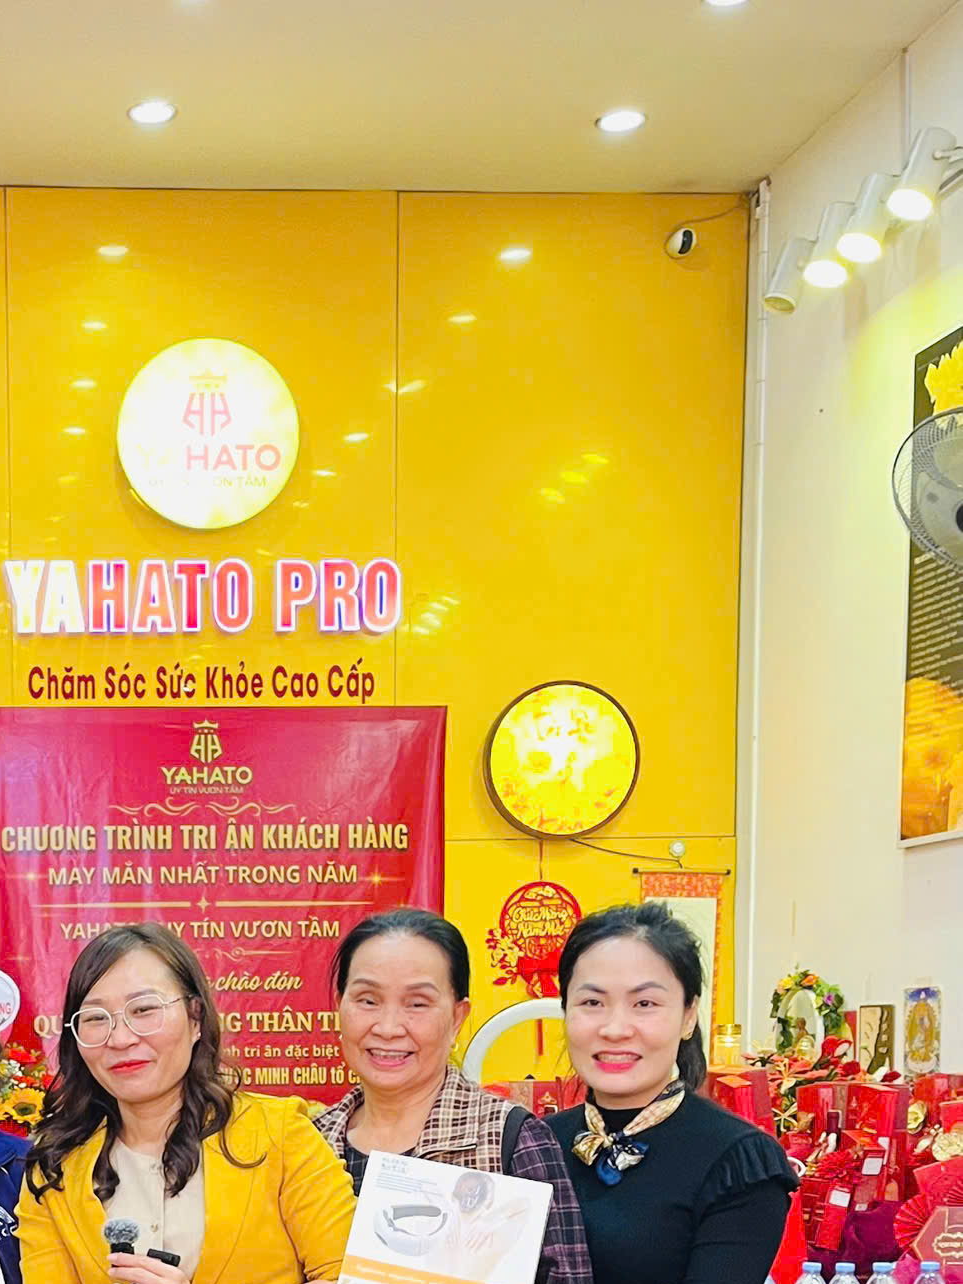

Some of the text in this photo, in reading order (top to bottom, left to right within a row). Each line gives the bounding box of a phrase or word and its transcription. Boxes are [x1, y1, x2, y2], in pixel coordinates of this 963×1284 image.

[4, 558, 402, 634] YAHATO PRO
[28, 657, 375, 704] Chăm Sóc Sức Khỏe Cao Cấp
[161, 766, 253, 785] YAHATO
[1, 816, 408, 852] CHƯƠNG TRÌNH TRI ÂN KHÁCH HÀNG
[48, 867, 95, 885] MAY
[160, 860, 219, 884] NHẤT
[225, 865, 300, 884] TRONG
[307, 860, 358, 884] NĂM
[189, 917, 225, 938] TÍN
[230, 920, 292, 938] VƯƠN
[215, 971, 263, 991] chào
[264, 971, 302, 991] đón
[246, 1005, 313, 1032] THÂN
[244, 1045, 260, 1057] tri
[264, 1045, 281, 1057] ân
[285, 1045, 309, 1060] đặc
[313, 1044, 339, 1060] biệt
[255, 1067, 289, 1085] MINH
[293, 1062, 327, 1085] CHÂU
